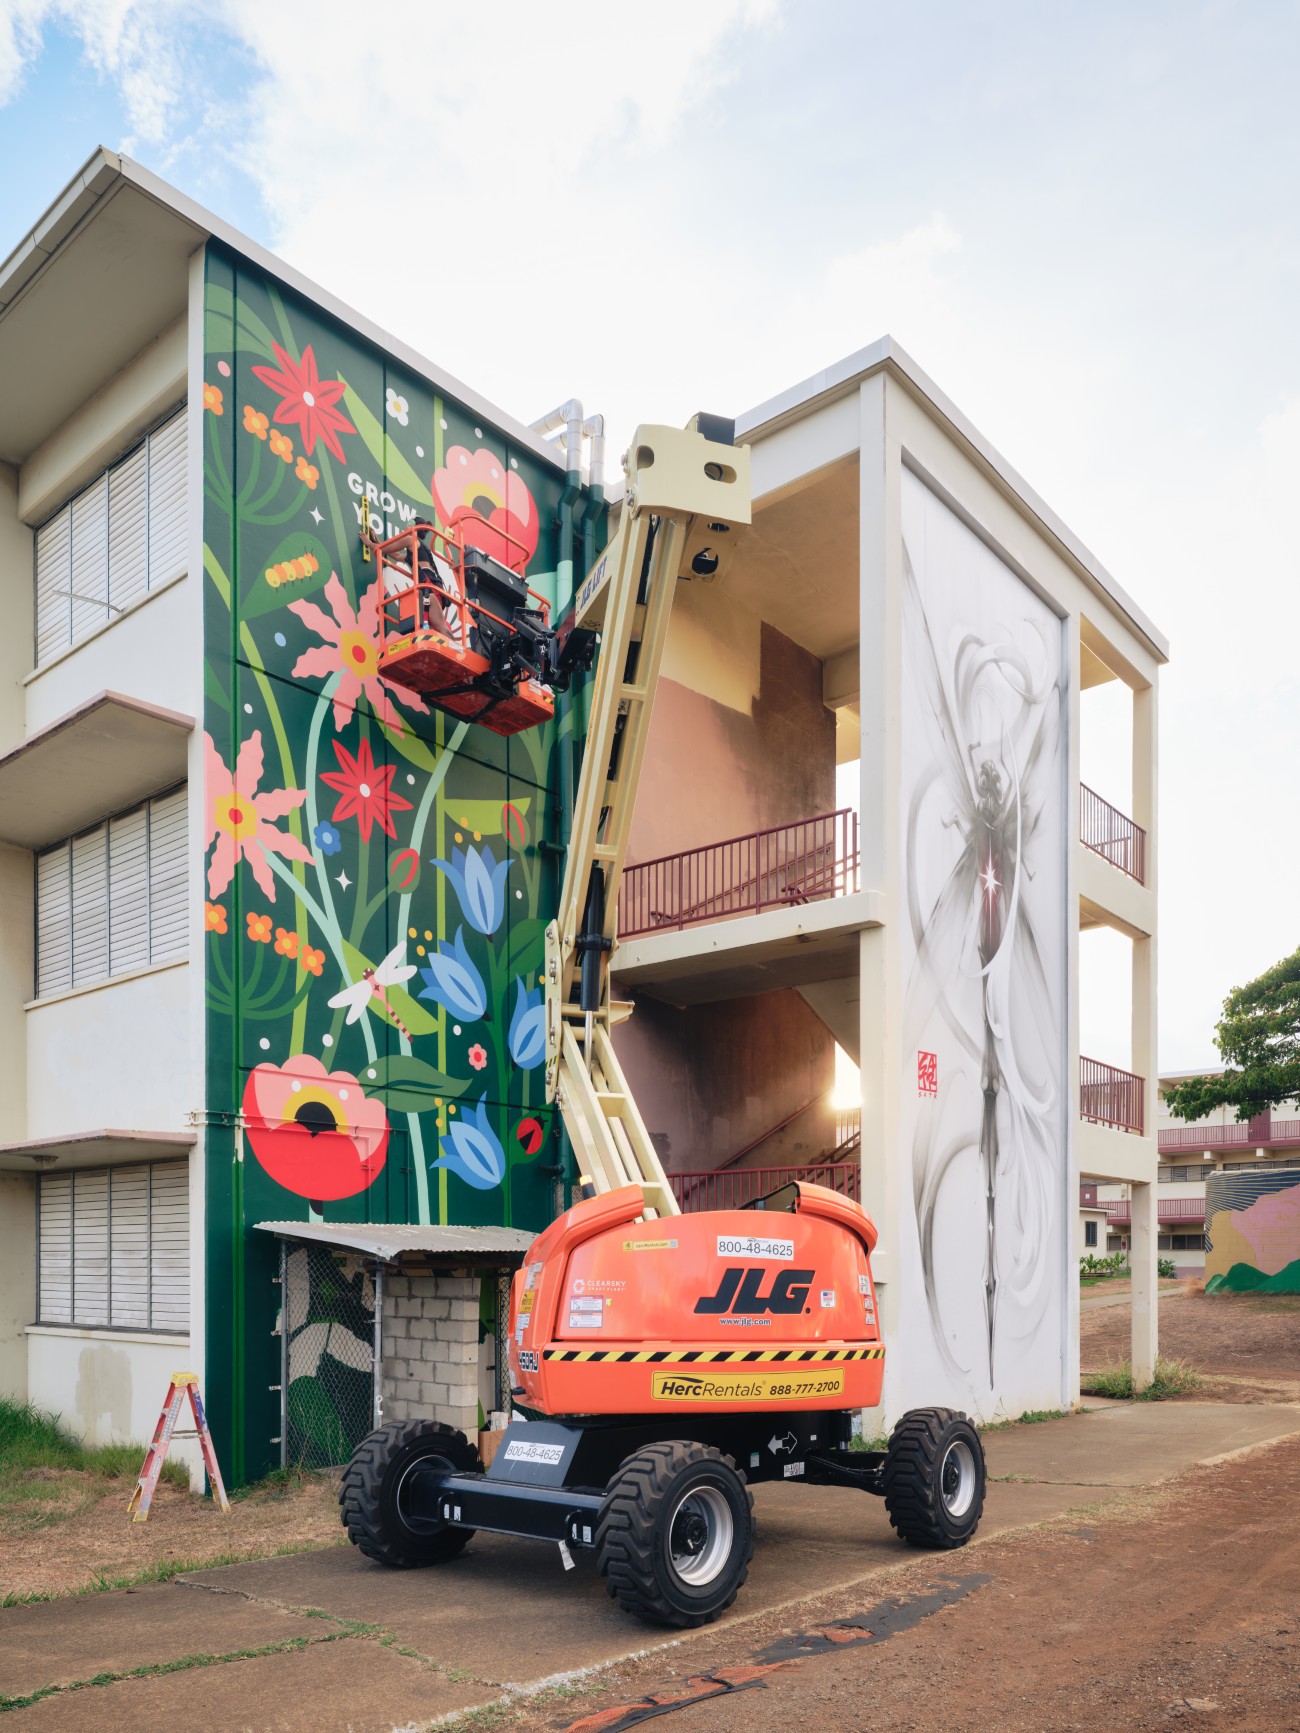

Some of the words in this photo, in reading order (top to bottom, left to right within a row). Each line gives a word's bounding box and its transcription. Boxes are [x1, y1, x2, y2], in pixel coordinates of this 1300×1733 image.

[347, 472, 417, 522] GROW
[718, 1241, 793, 1257] 800-48-4625
[693, 1268, 815, 1315] JLG
[720, 1317, 771, 1326] www.jlg.com
[769, 1380, 840, 1396] 888-777-2700
[506, 1445, 562, 1461] 800-48-4625
